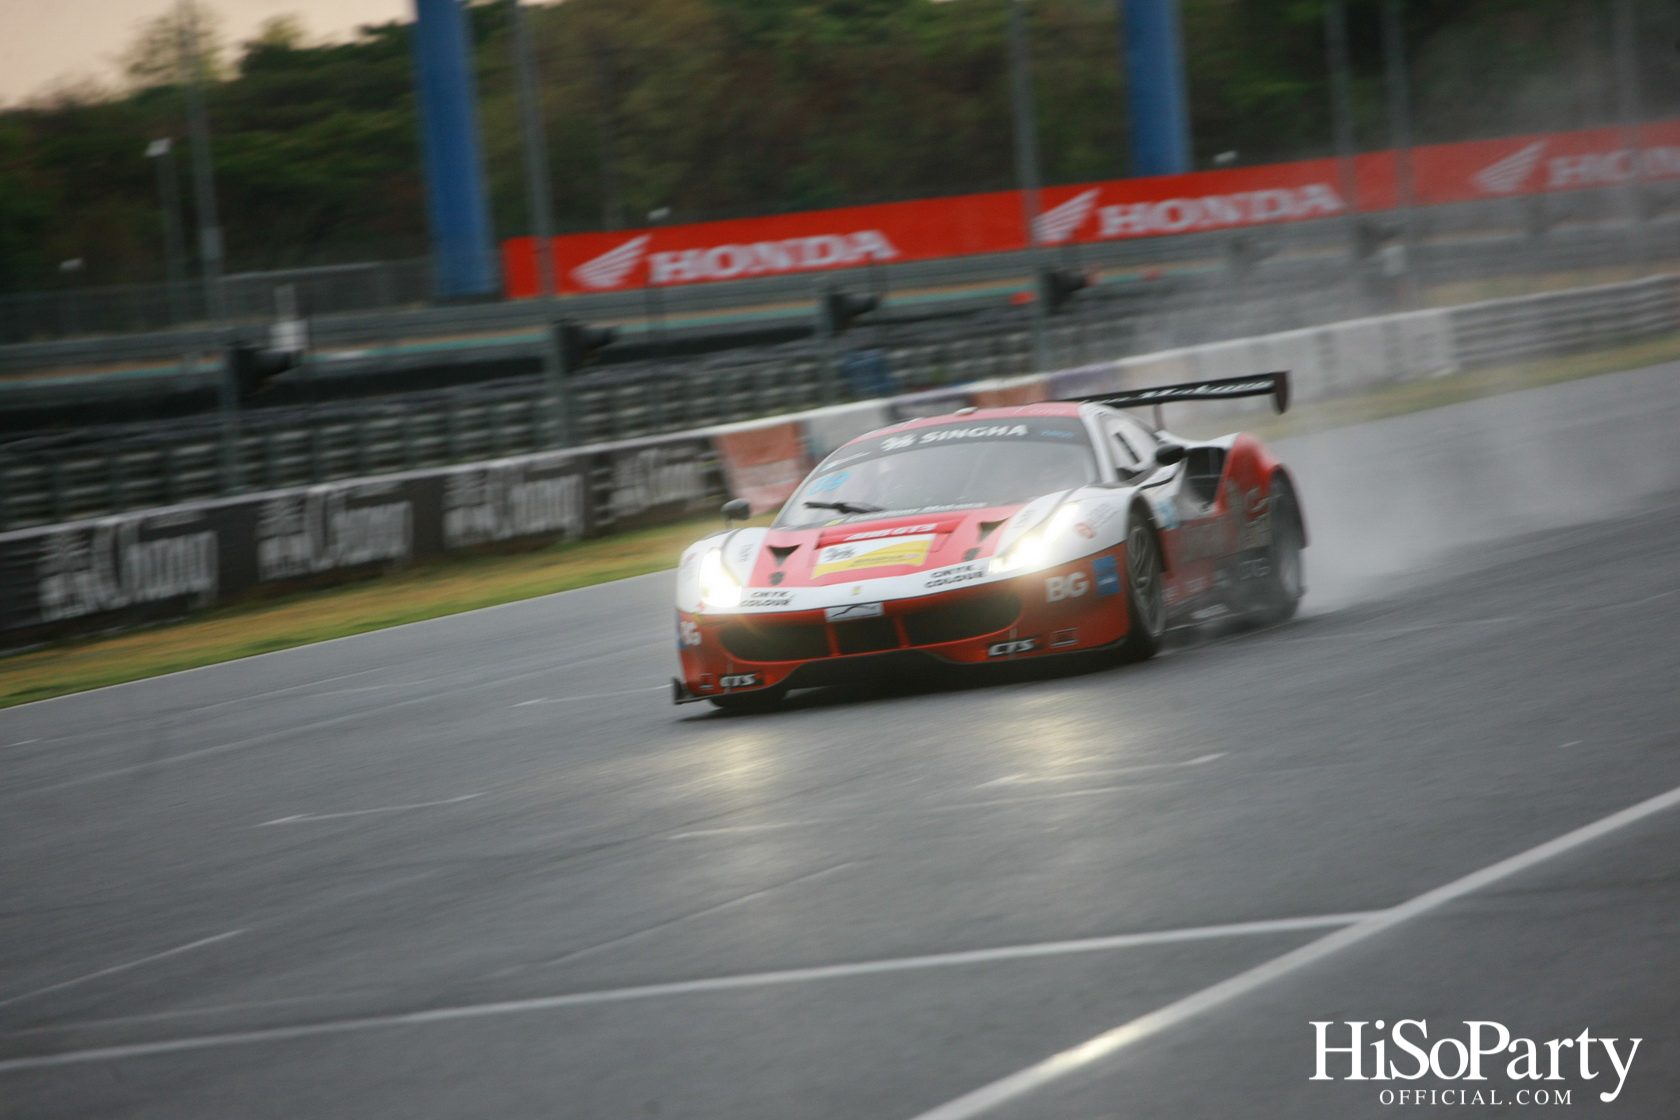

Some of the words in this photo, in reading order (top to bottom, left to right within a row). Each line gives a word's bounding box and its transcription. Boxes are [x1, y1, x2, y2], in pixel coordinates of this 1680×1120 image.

[1098, 183, 1343, 237] HONDA
[647, 230, 898, 284] HONDA
[918, 424, 1030, 445] SINGHA
[1045, 572, 1090, 602] BG
